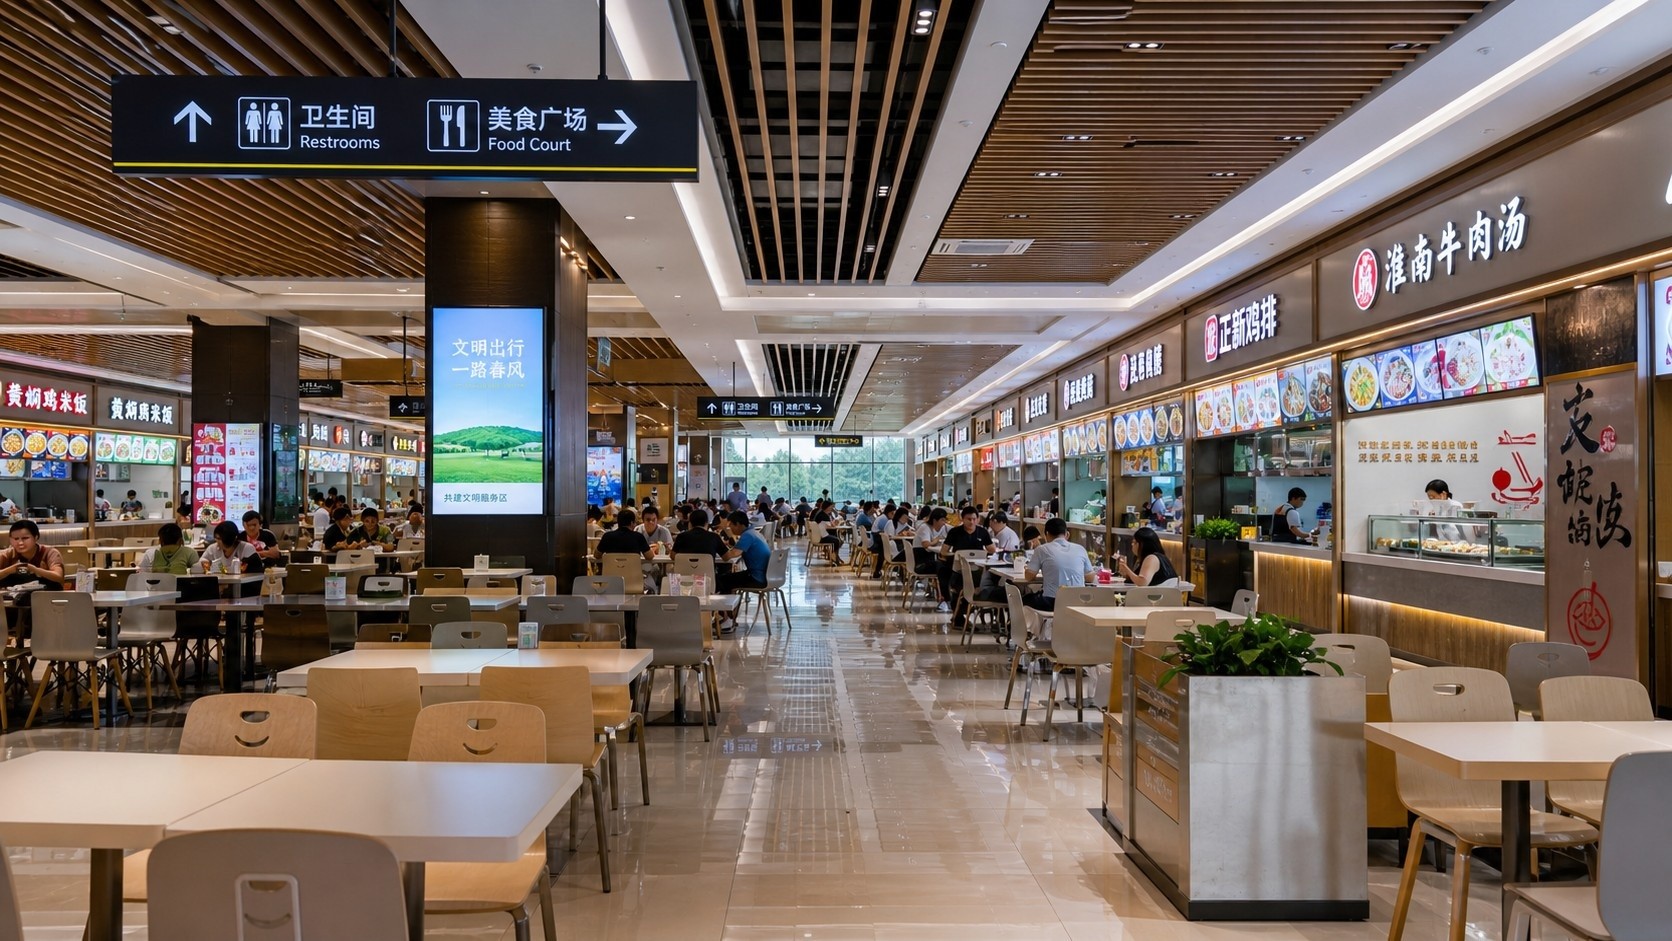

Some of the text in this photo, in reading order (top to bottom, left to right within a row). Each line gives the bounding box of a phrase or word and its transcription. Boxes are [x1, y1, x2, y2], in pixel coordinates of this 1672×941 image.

[299, 103, 375, 130] 卫生间
[488, 106, 587, 132] 美食广场
[300, 135, 381, 150] Restrooms
[488, 137, 572, 152] Food Court
[1384, 195, 1527, 294] 淮南牛肉汤
[1219, 293, 1277, 354] 正新鸡排
[452, 338, 525, 357] 文明出行
[452, 360, 525, 379] 一路春风
[6, 382, 88, 415] 黄焖鸡米饭
